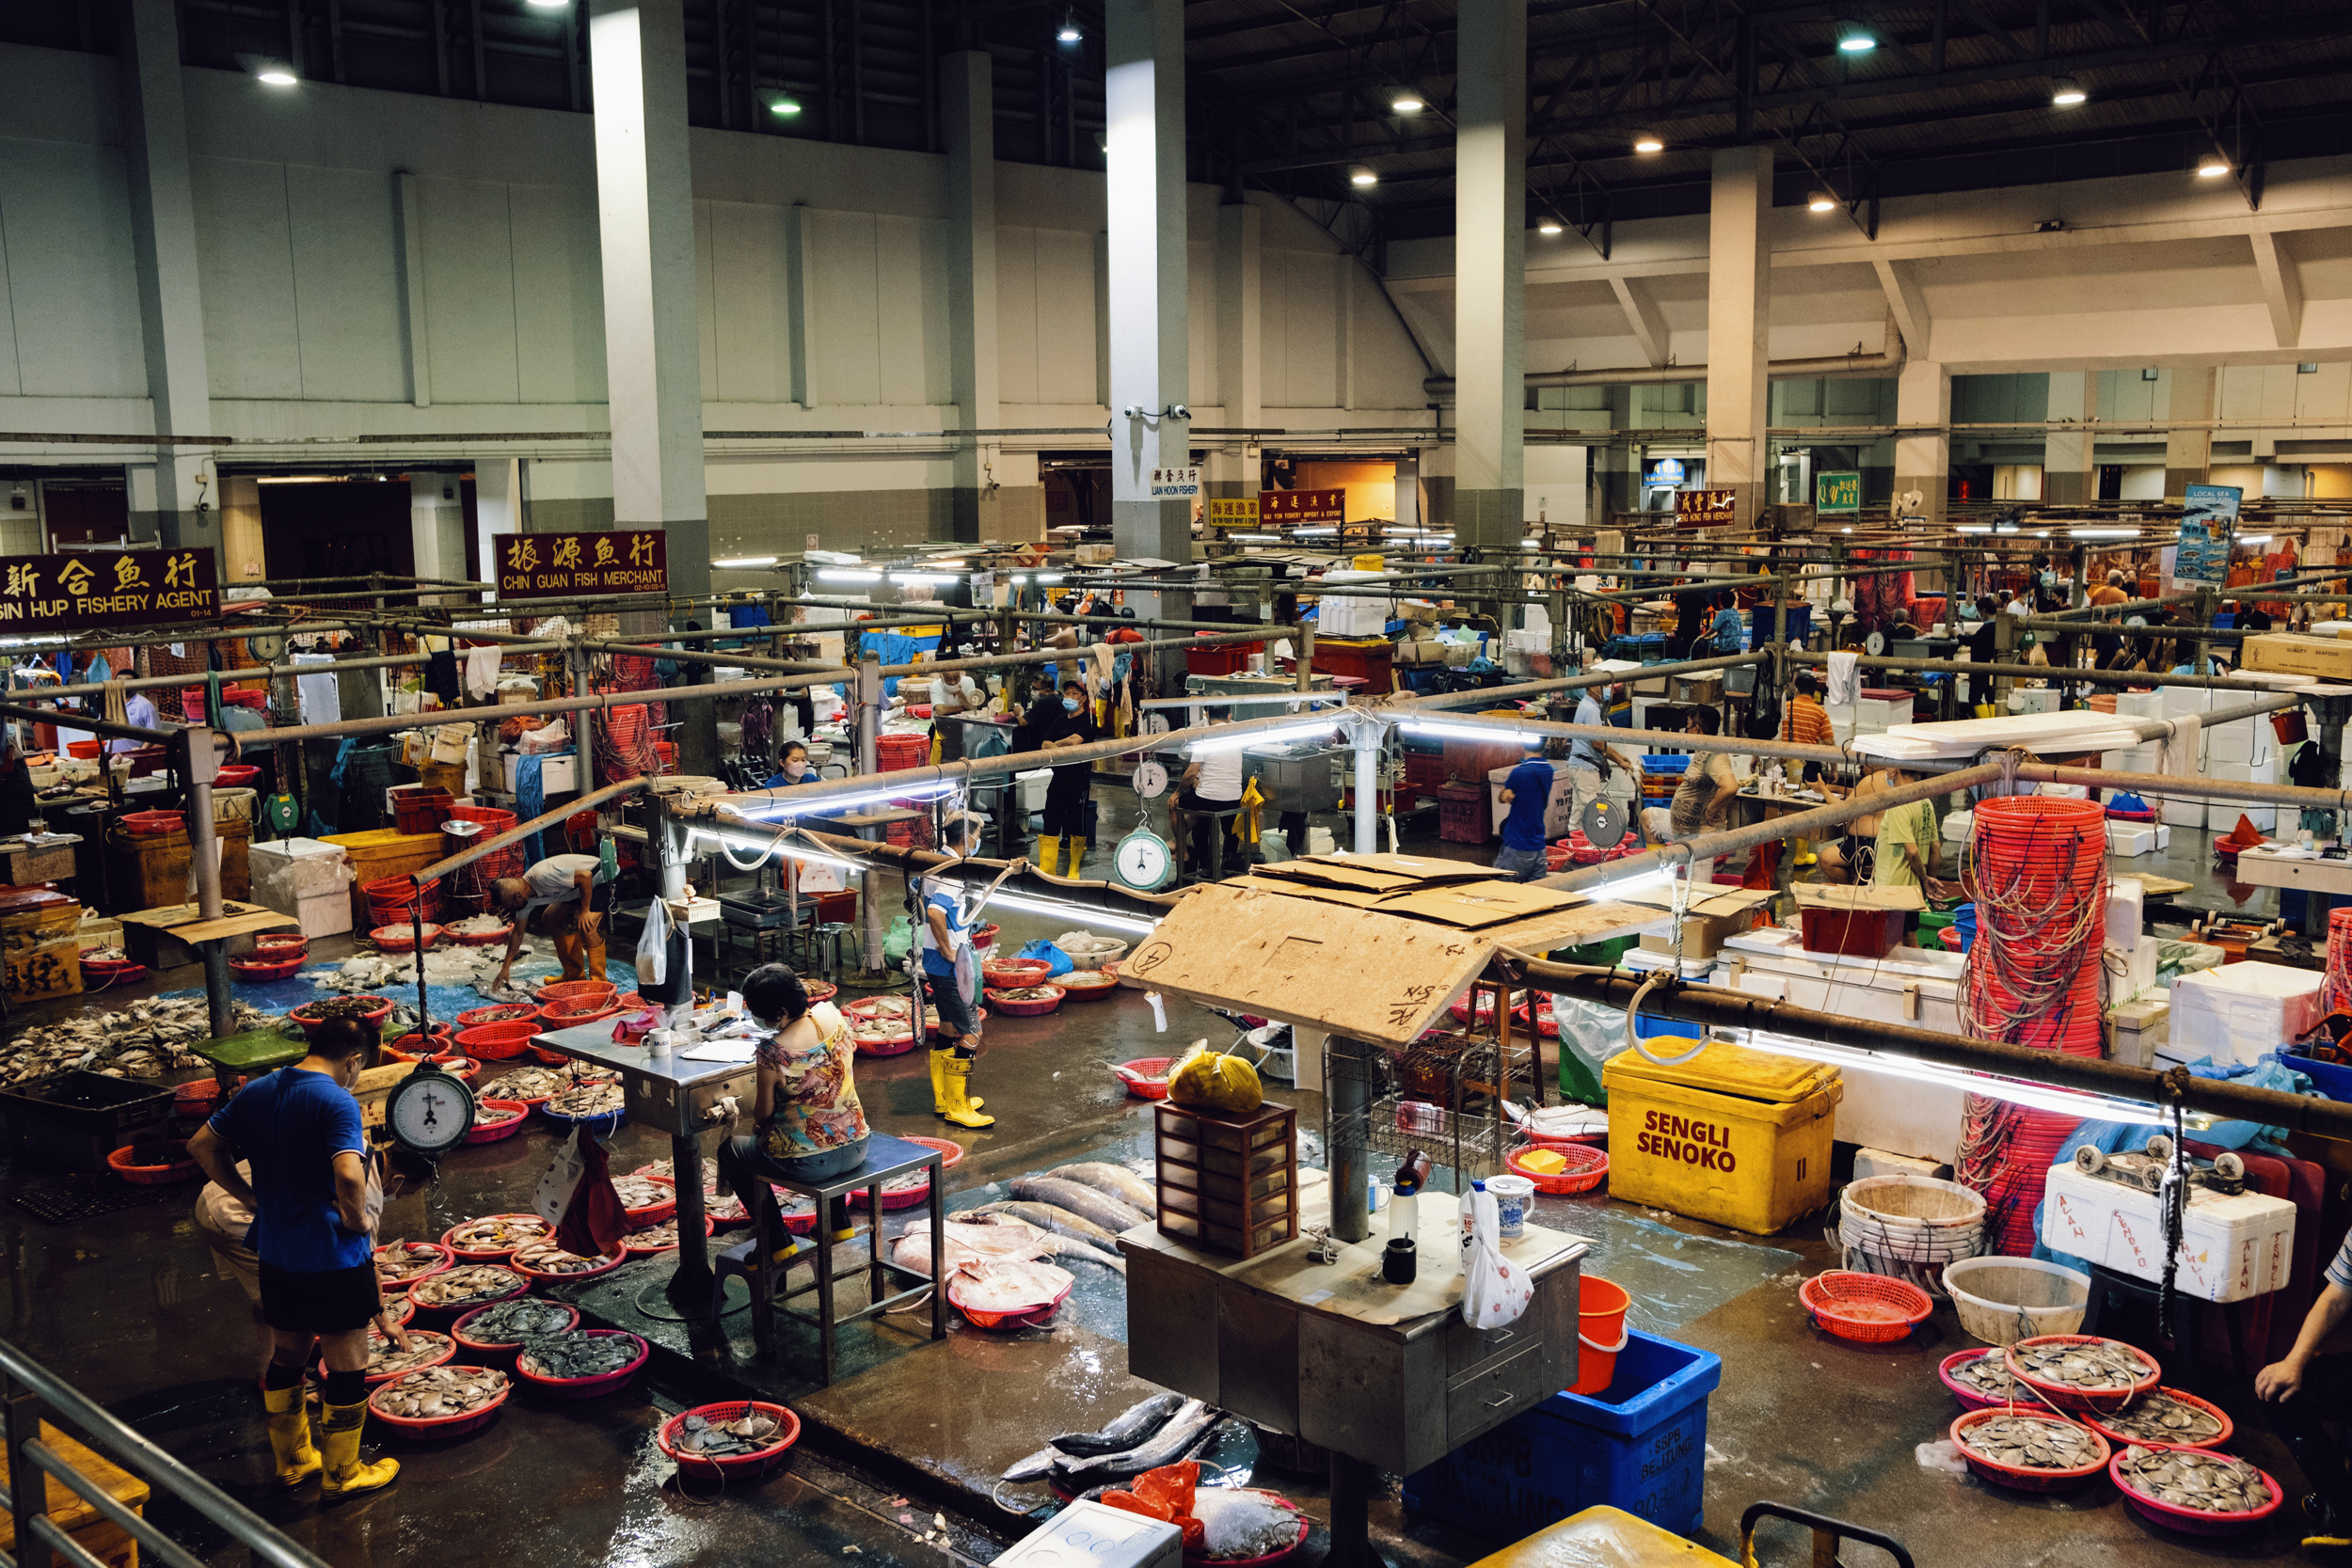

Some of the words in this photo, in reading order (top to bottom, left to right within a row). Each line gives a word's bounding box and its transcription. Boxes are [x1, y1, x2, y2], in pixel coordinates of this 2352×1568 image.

[1152, 485, 1164, 496] LIAN
[1164, 485, 1179, 496] HOON
[1179, 484, 1199, 495] FISHERY
[1212, 501, 1258, 515] 海運漁業
[1689, 513, 1702, 521] HONG
[1703, 512, 1712, 521] FISH
[1713, 511, 1734, 520] MERCHANT
[507, 533, 657, 573] 振源魚行
[3, 552, 198, 598] 新合魚行
[503, 575, 531, 591] CHIN
[536, 573, 568, 589] GUAN
[575, 572, 597, 587] FISH
[604, 569, 663, 585] MERCHANT
[30, 599, 70, 618] HUP
[77, 594, 150, 614] FISHERY
[155, 589, 213, 610] AGENT
[191, 609, 212, 617] 01-14
[1645, 1110, 1729, 1149] SENGLI
[1637, 1132, 1736, 1173] SENOKO
[2240, 1240, 2250, 1291] ALAN
[1655, 1427, 1681, 1454] SSPB
[1641, 1436, 1692, 1480] BELITUNG
